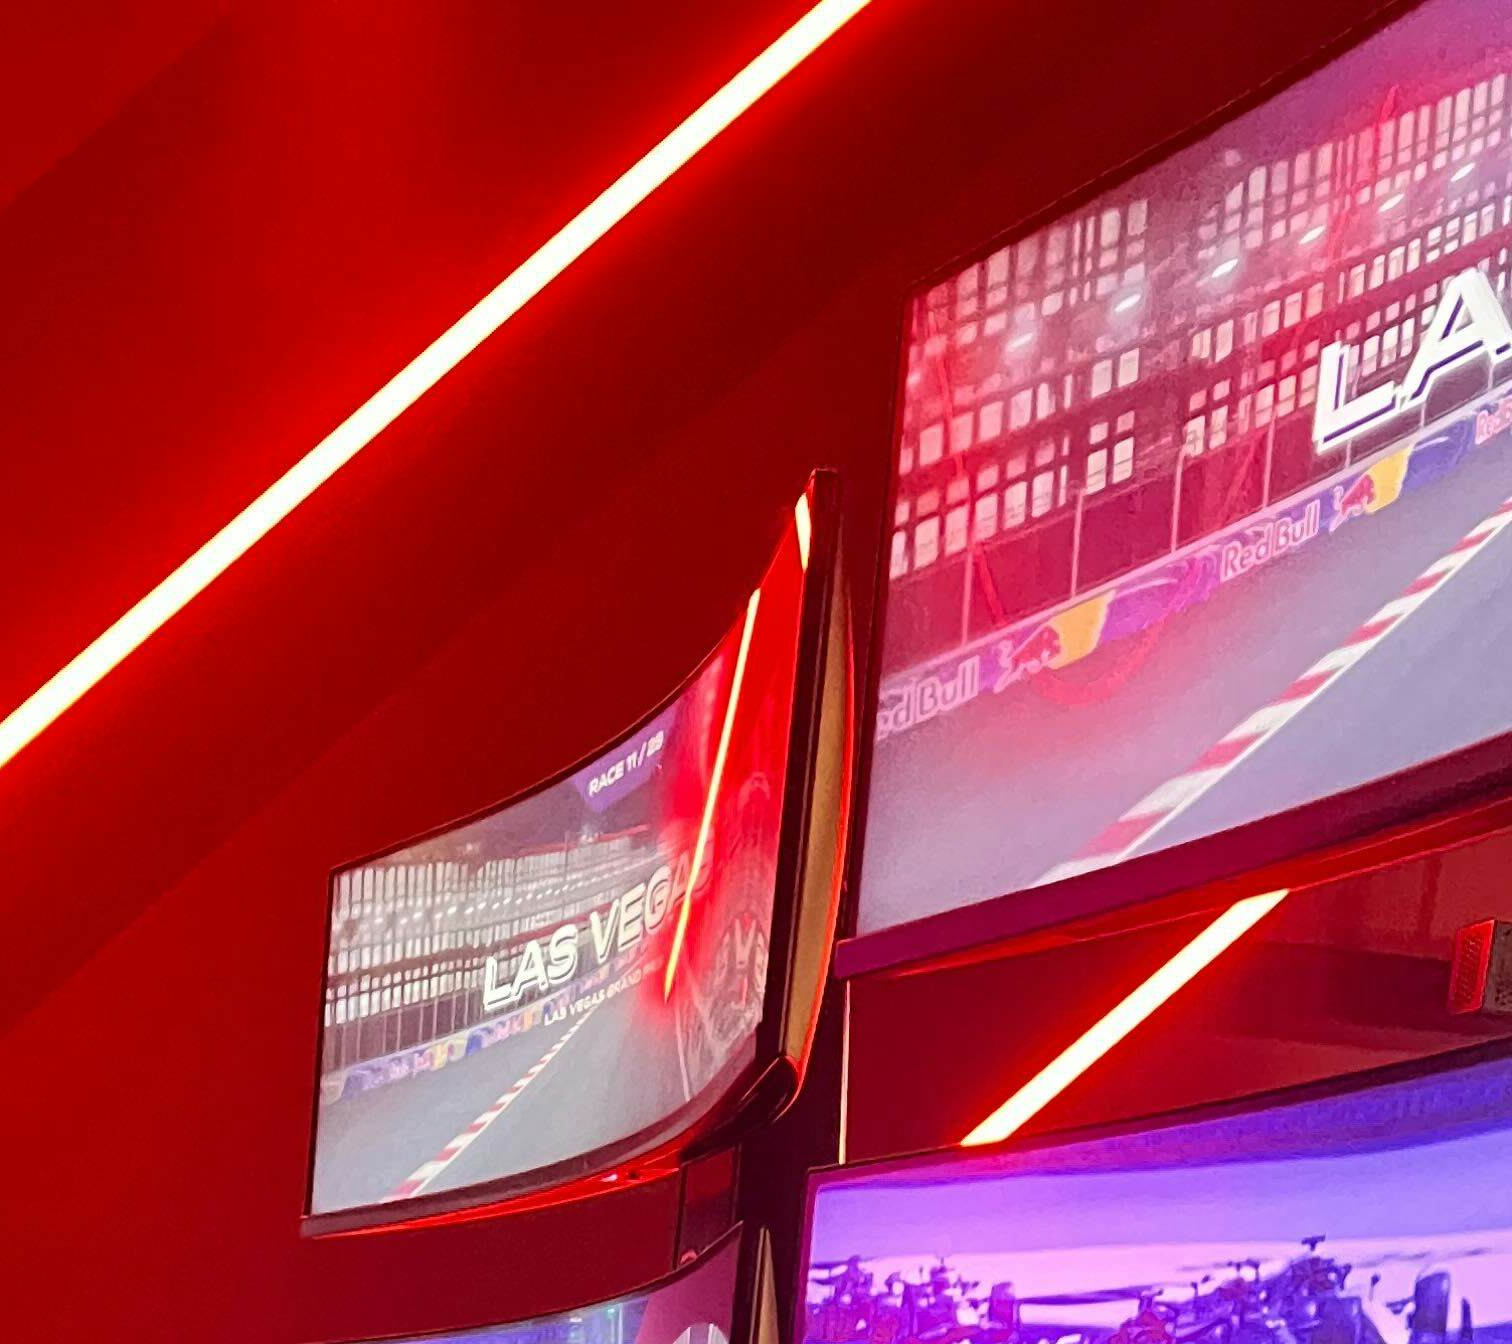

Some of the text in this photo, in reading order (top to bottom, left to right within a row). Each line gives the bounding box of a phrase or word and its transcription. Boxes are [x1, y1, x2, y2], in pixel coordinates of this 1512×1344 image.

[1220, 499, 1320, 583] Red Bull
[916, 655, 980, 723] Bull
[588, 760, 625, 797] RACE
[483, 924, 578, 1011] LAS
